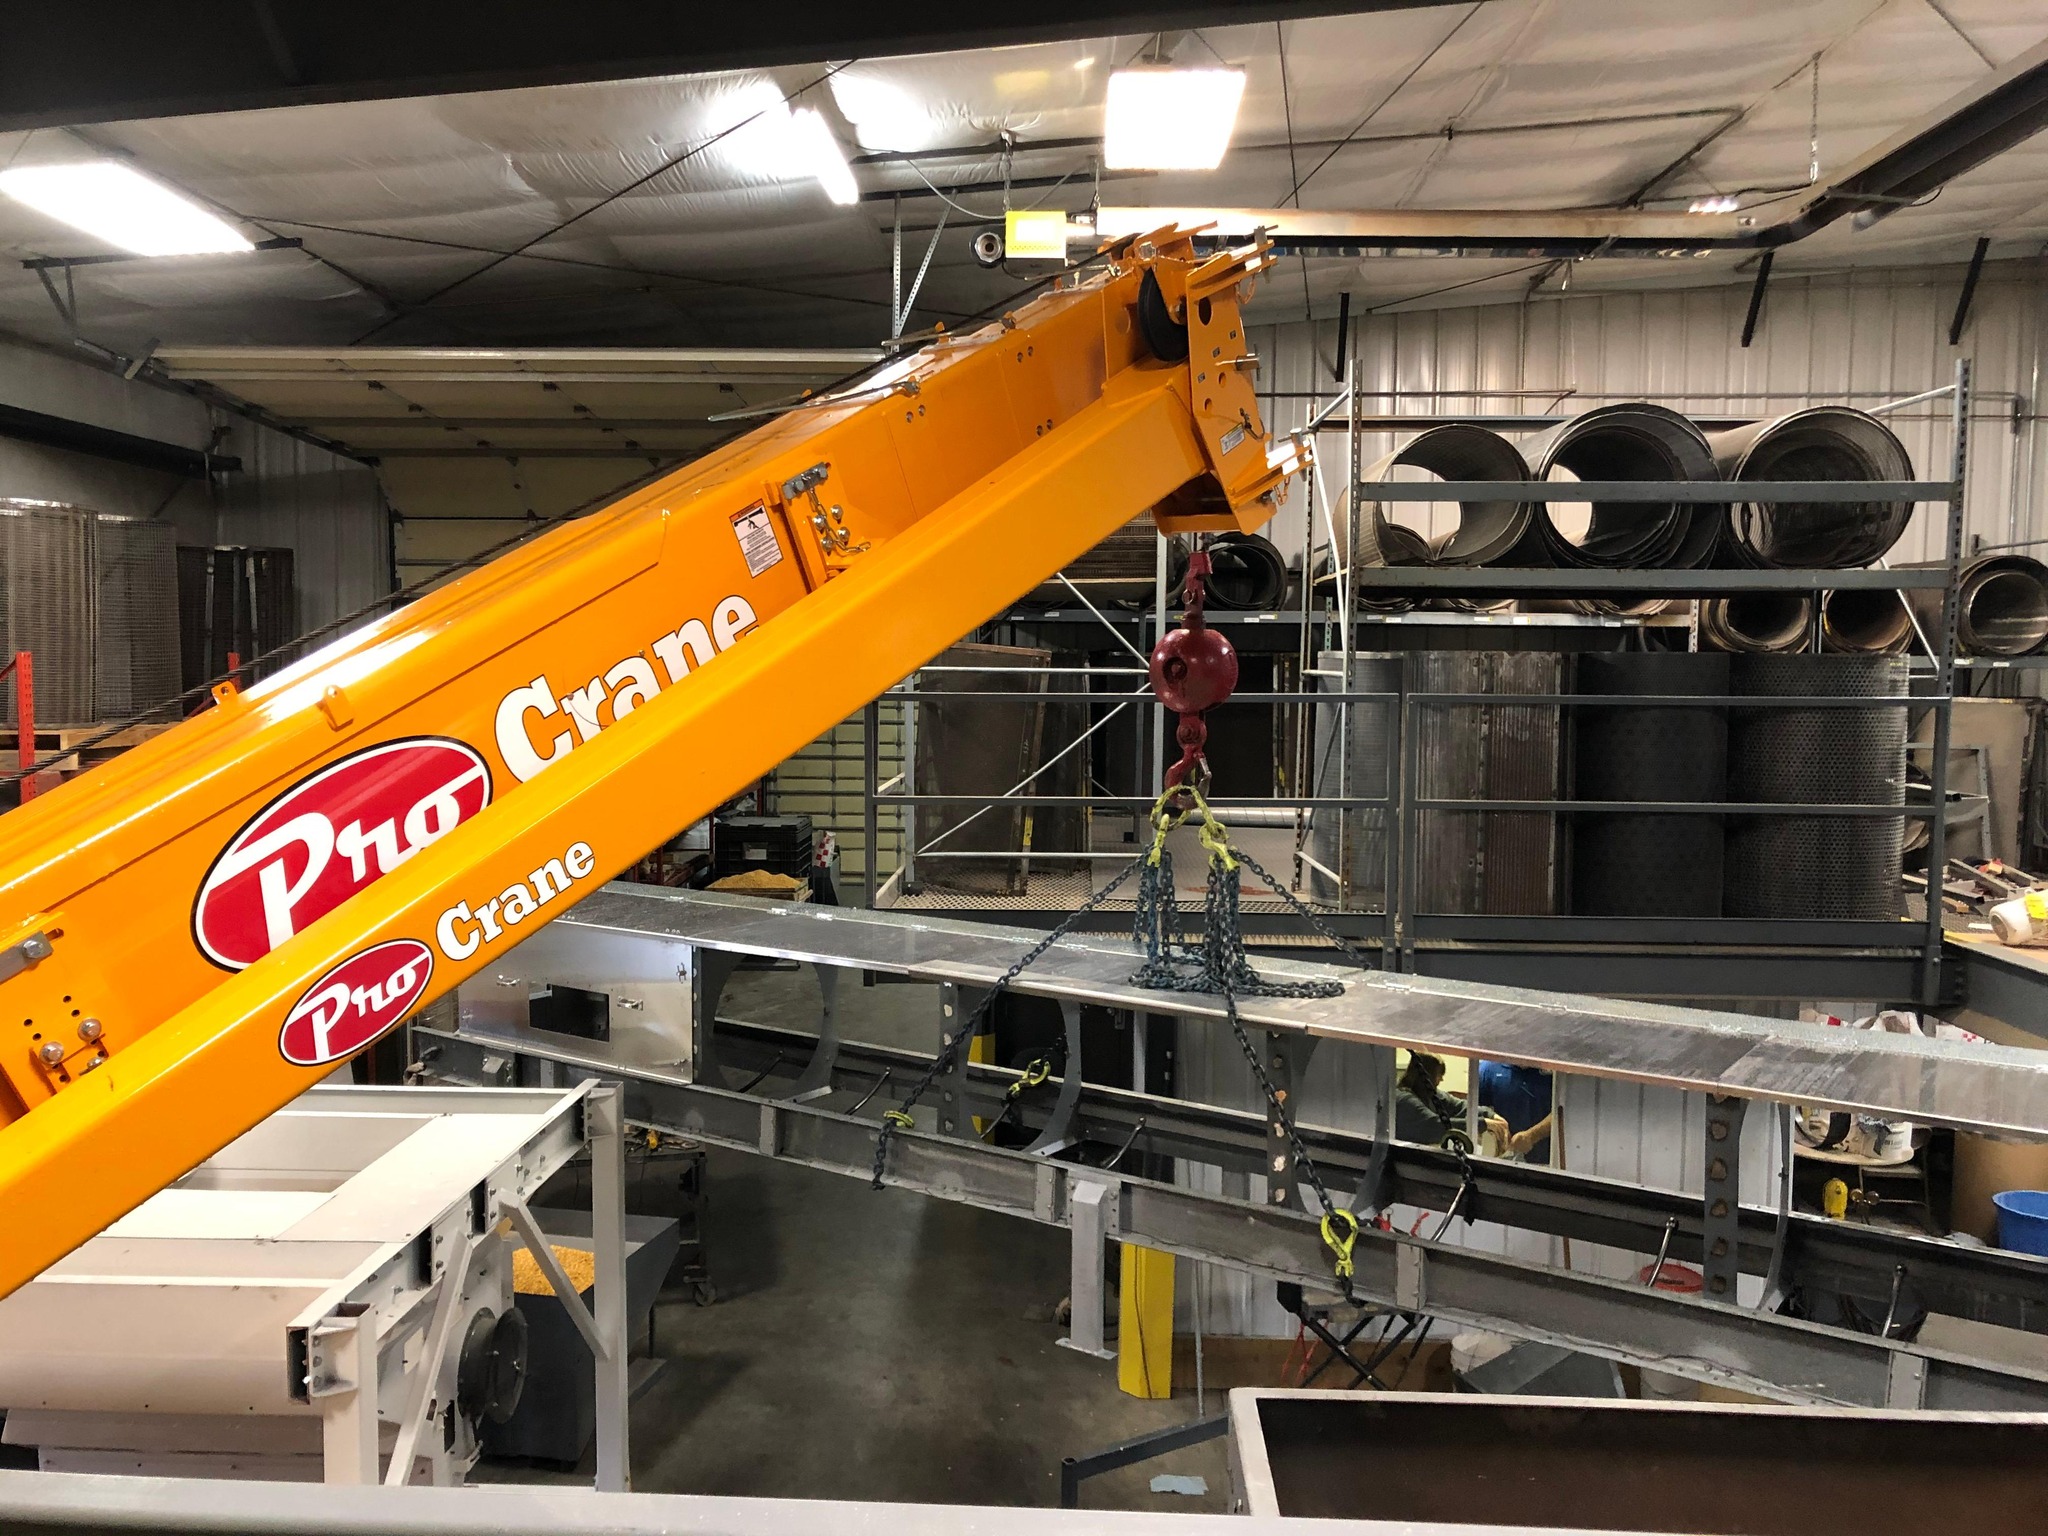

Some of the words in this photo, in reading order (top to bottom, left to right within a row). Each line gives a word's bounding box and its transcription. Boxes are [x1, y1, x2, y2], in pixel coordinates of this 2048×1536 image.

[206, 768, 483, 952] Pro
[494, 595, 759, 783] Crane
[286, 952, 430, 1060] Pro
[436, 841, 595, 961] Crane
